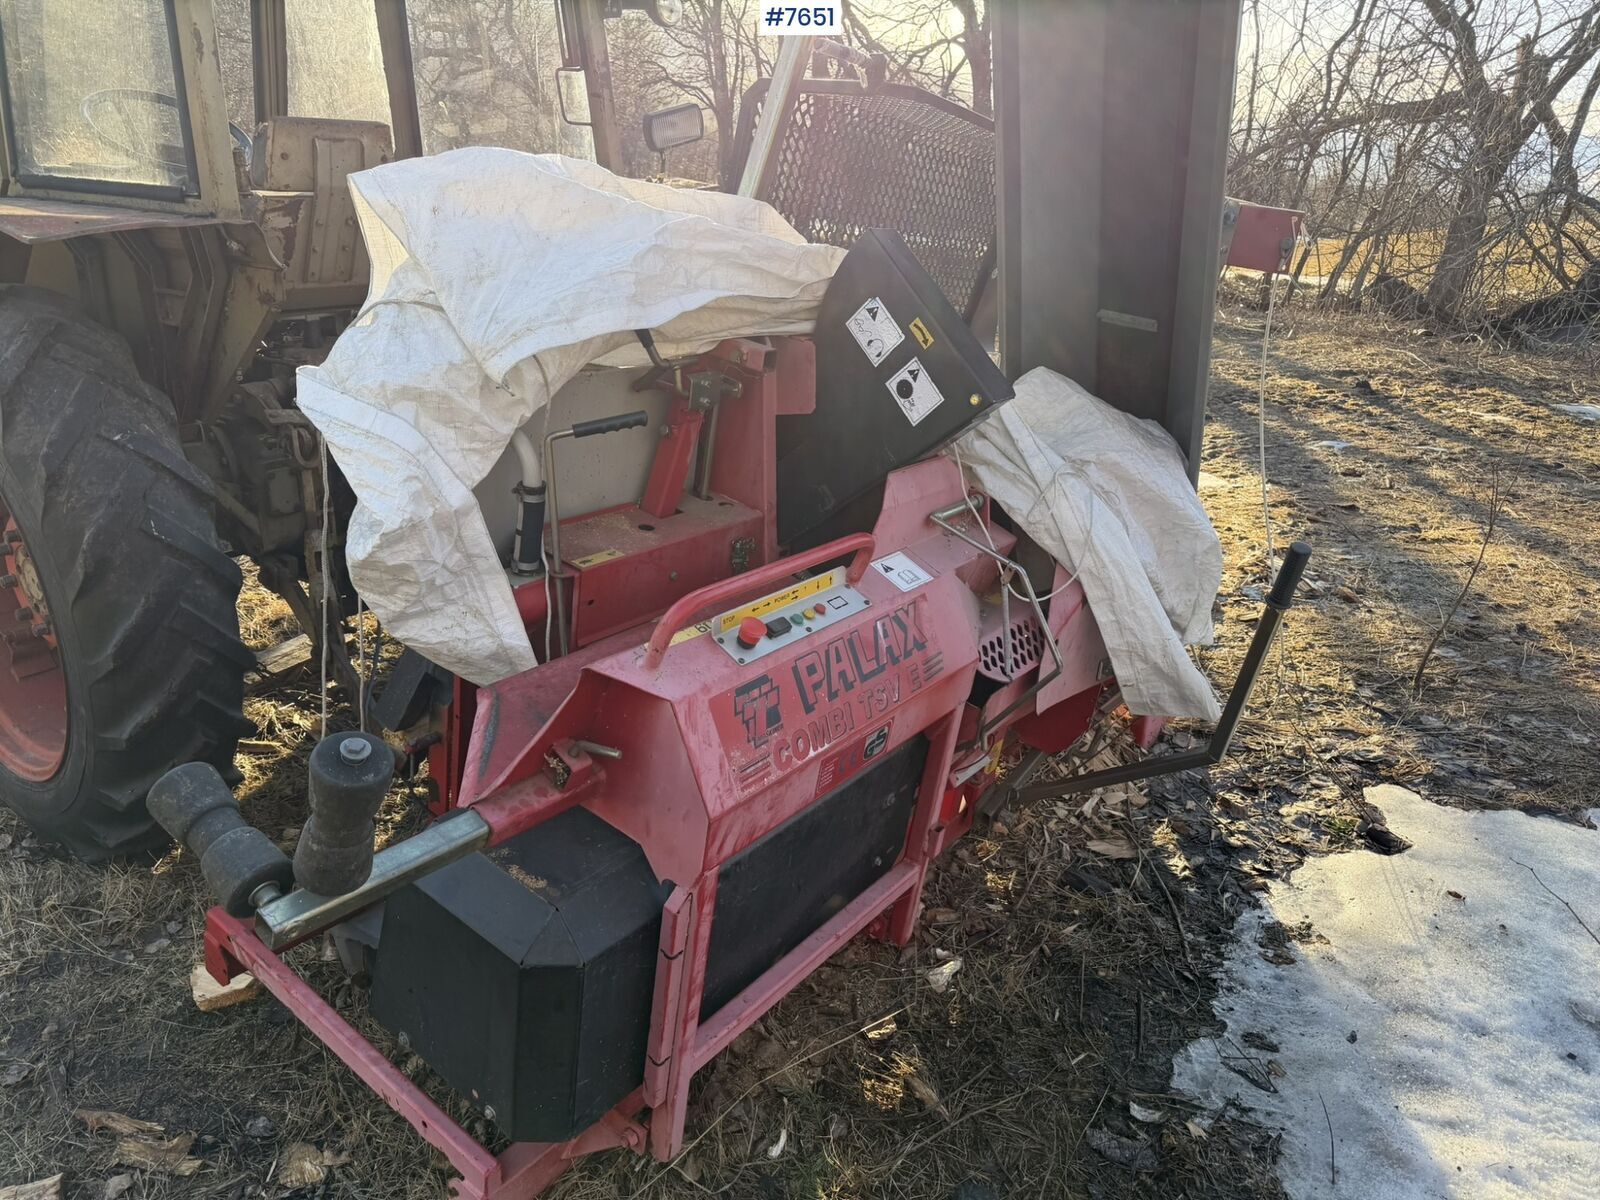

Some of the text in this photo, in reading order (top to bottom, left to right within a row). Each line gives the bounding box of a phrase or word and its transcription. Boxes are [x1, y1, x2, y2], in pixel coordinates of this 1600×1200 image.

[791, 600, 928, 715] PALAX
[773, 701, 855, 772] COMBI
[858, 673, 900, 719] TSV
[908, 662, 922, 693] E
